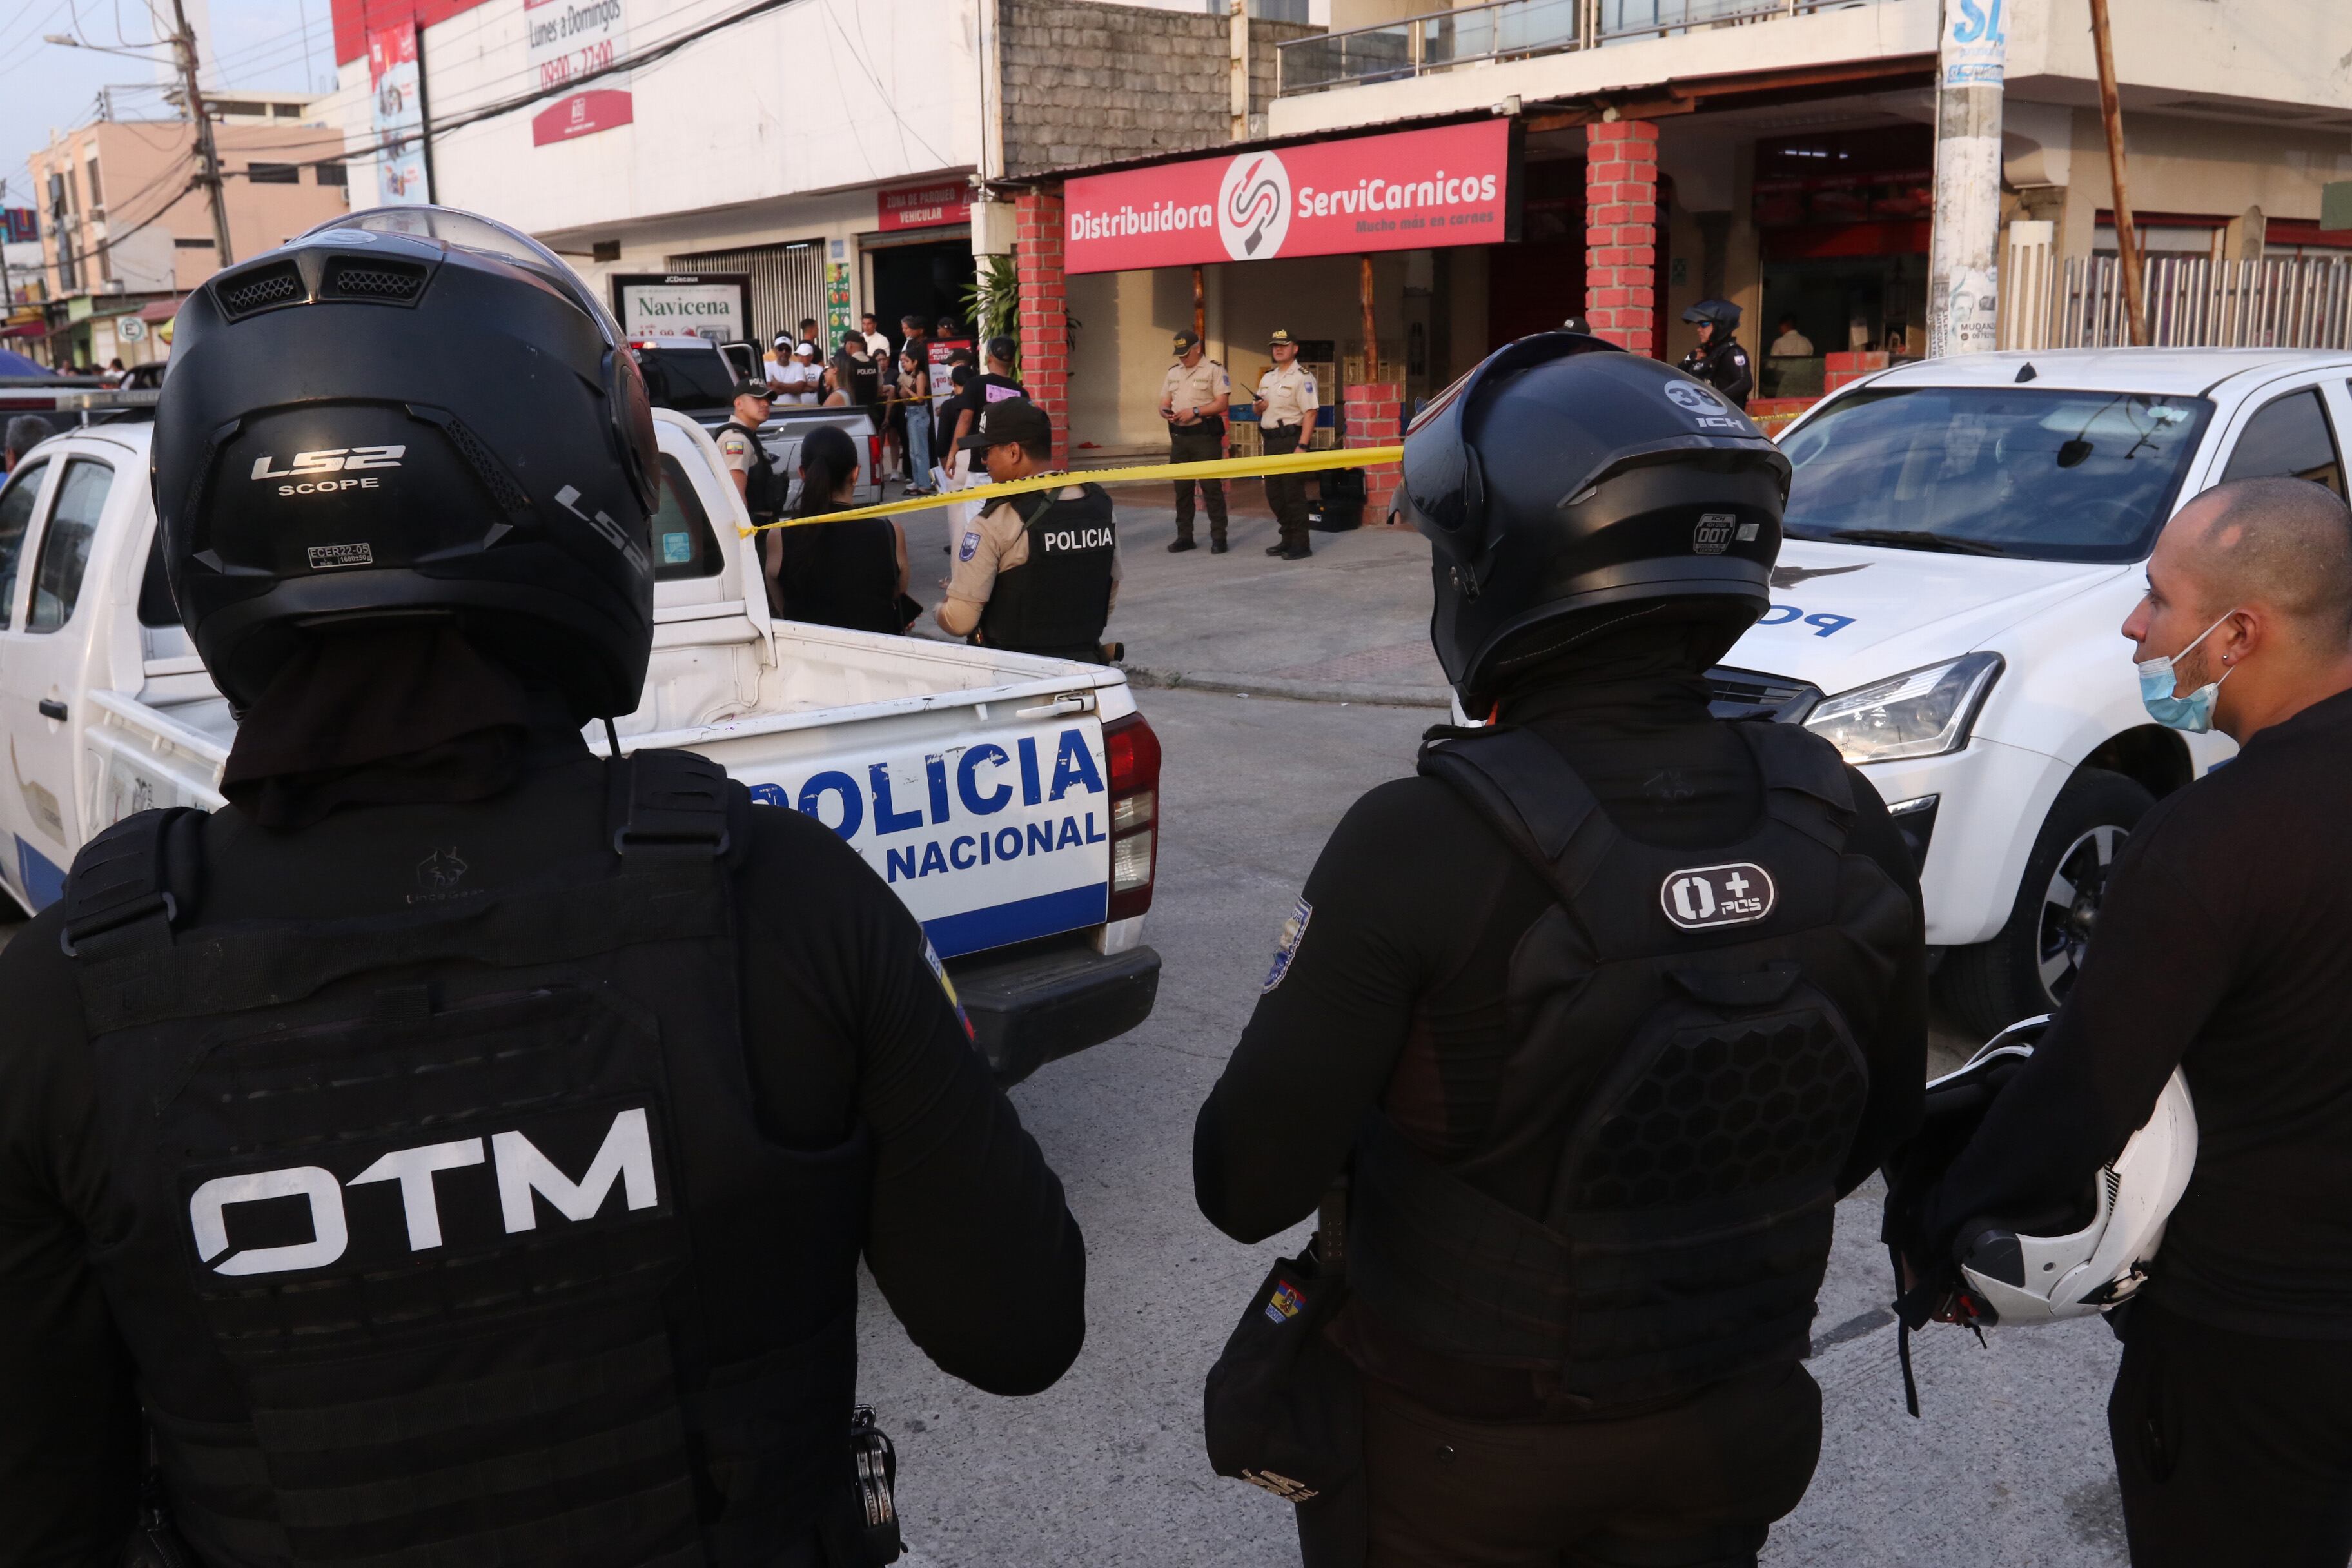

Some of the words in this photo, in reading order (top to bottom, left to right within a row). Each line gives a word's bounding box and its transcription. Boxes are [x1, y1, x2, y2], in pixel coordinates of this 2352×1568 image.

[529, 20, 558, 48] Lunes
[560, 15, 567, 38] a
[887, 195, 906, 208] ZONA
[908, 193, 917, 206] DE
[919, 188, 956, 204] PARQUEO
[1298, 170, 1496, 218] ServiCarnicos
[899, 207, 943, 224] VEHICULAR
[1071, 201, 1212, 240] Distribuidora
[1356, 219, 1396, 233] Mucho
[1400, 213, 1426, 230] más
[1430, 216, 1445, 227] en
[1449, 211, 1494, 224] carnes
[638, 297, 730, 316] Navicena
[251, 444, 406, 480] LS2
[278, 477, 380, 496] SCOPE
[1044, 527, 1113, 551] POLICIA
[1698, 528, 1729, 543] DOT
[887, 812, 1107, 883] NACIONAL
[190, 1107, 658, 1277] OTM
